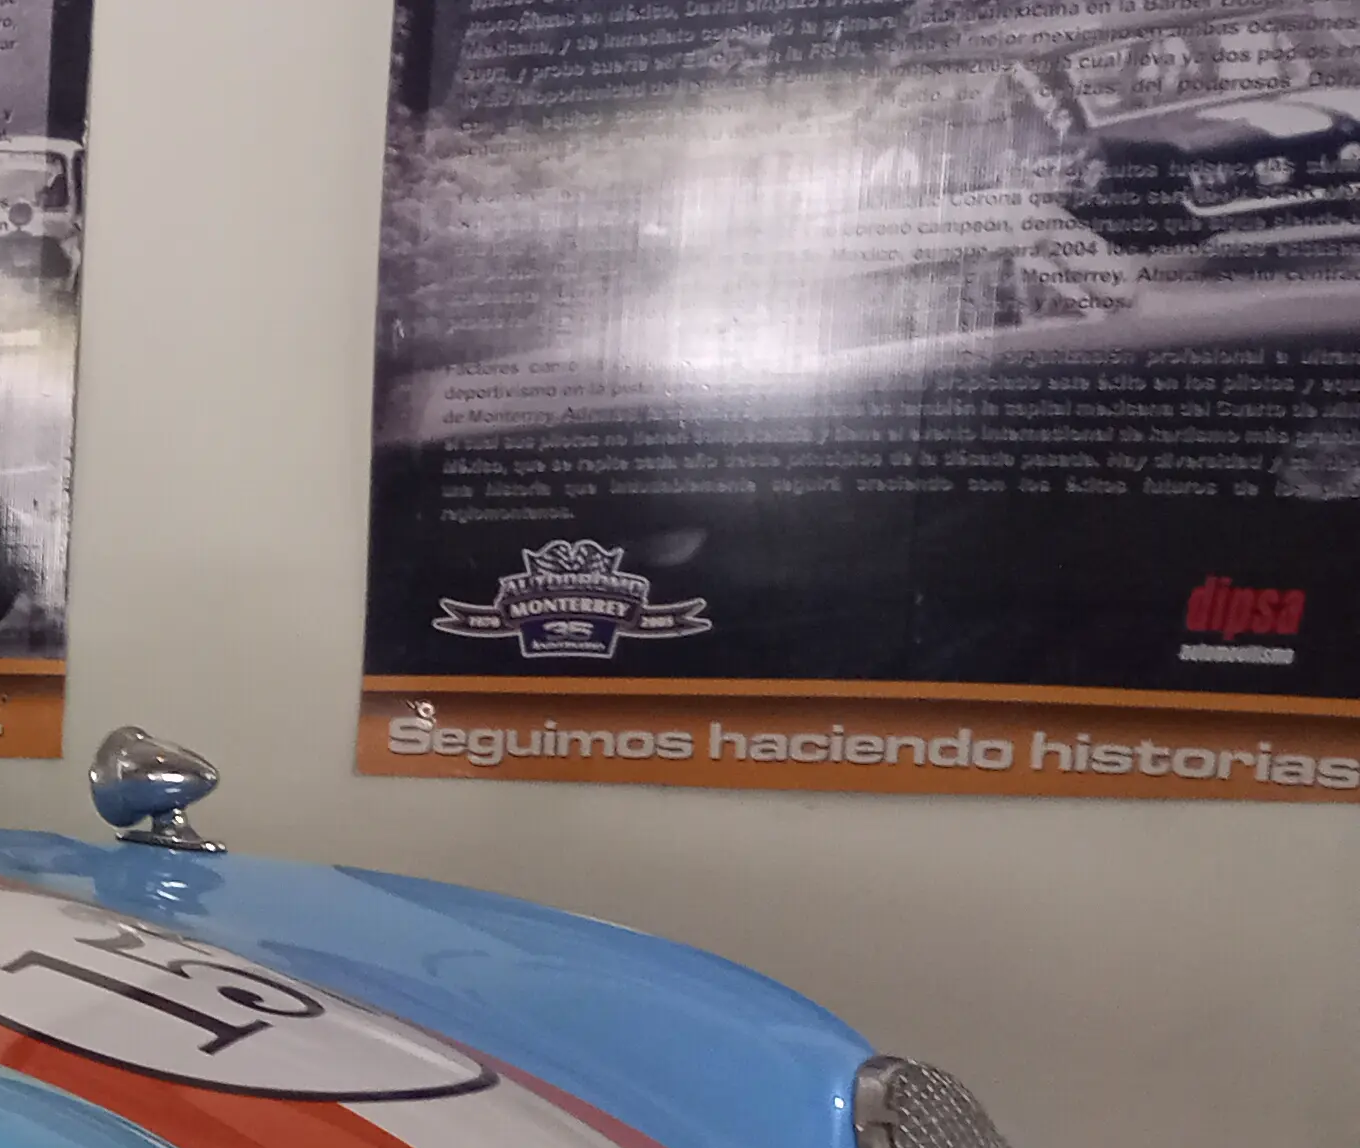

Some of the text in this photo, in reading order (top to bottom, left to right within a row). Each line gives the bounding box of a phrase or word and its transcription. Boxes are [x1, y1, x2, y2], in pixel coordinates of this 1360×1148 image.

[1022, 267, 1123, 285] Monterrey.
[510, 598, 630, 618] MONTERREY
[1186, 573, 1306, 641] dipsa
[542, 621, 594, 640] 35
[388, 715, 1360, 790] Seguimos haciendo historias
